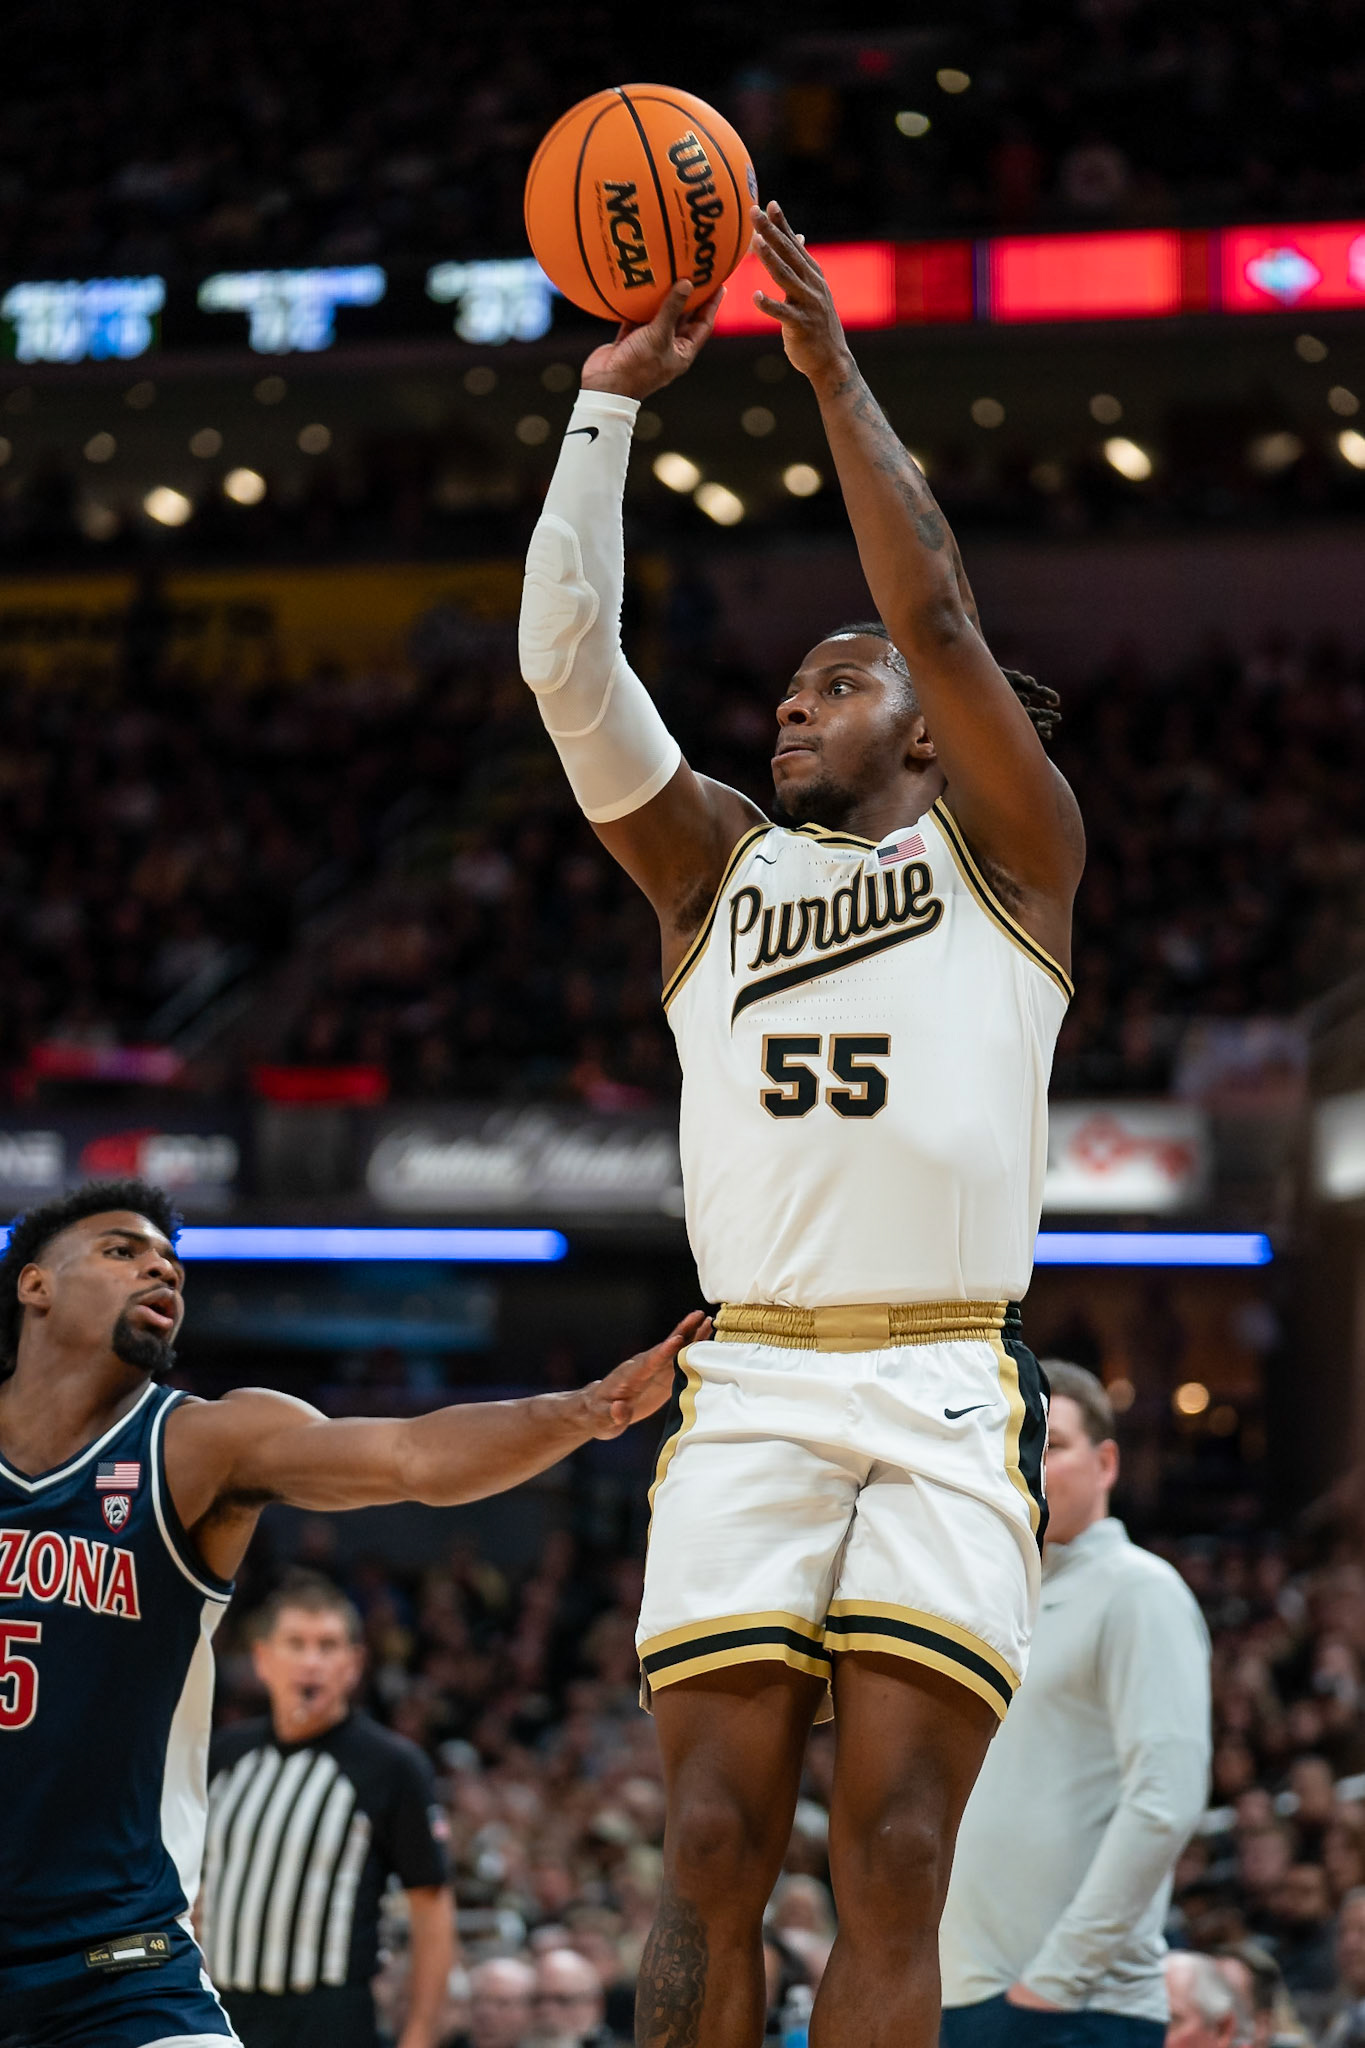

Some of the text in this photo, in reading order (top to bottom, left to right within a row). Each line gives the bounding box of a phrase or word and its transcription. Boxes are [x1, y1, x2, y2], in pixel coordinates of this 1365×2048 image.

[603, 179, 655, 290] NCAA
[667, 130, 724, 288] Wilson
[730, 860, 942, 977] Purdue
[760, 1033, 892, 1120] 55
[149, 1939, 166, 1951] 48
